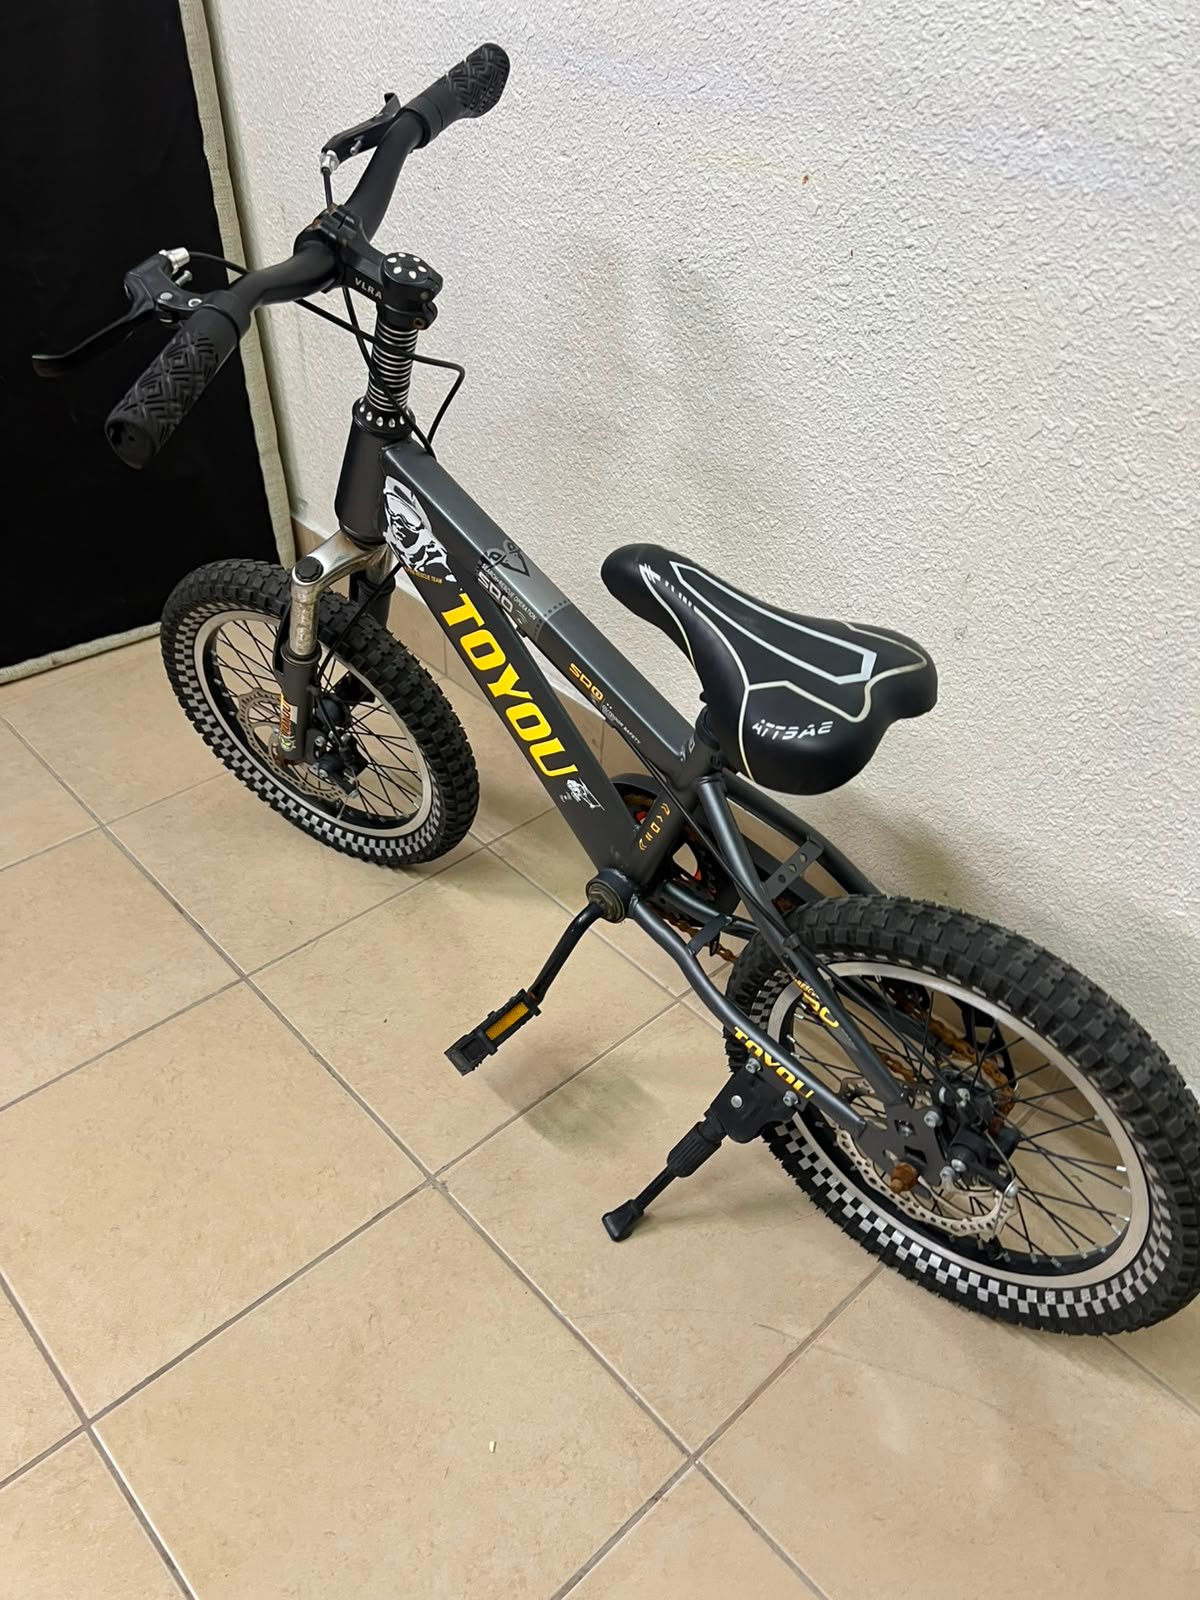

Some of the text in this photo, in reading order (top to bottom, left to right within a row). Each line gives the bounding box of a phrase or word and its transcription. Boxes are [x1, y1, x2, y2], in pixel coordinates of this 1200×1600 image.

[355, 277, 382, 299] VLRA
[513, 596, 537, 620] OPERATION
[441, 592, 579, 777] TOYOU
[623, 726, 640, 743] SAFETY
